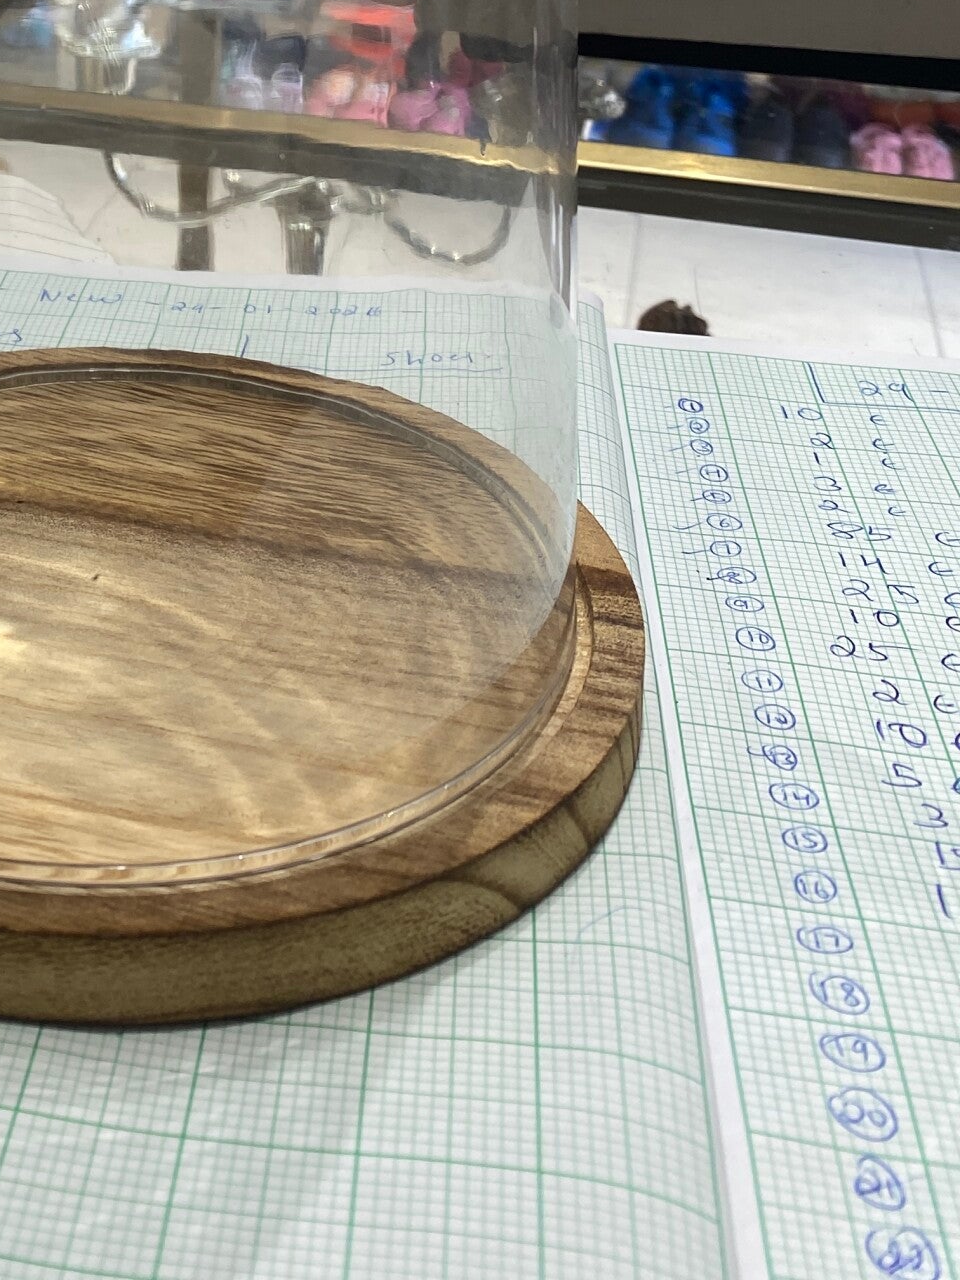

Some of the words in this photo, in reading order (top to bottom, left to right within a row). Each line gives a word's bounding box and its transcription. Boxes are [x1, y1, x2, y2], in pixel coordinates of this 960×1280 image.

[39, 287, 123, 305] New
[779, 404, 823, 422] 10
[837, 550, 889, 575] 14
[848, 607, 901, 628] 10
[871, 678, 910, 706] 2
[912, 802, 950, 829] 3
